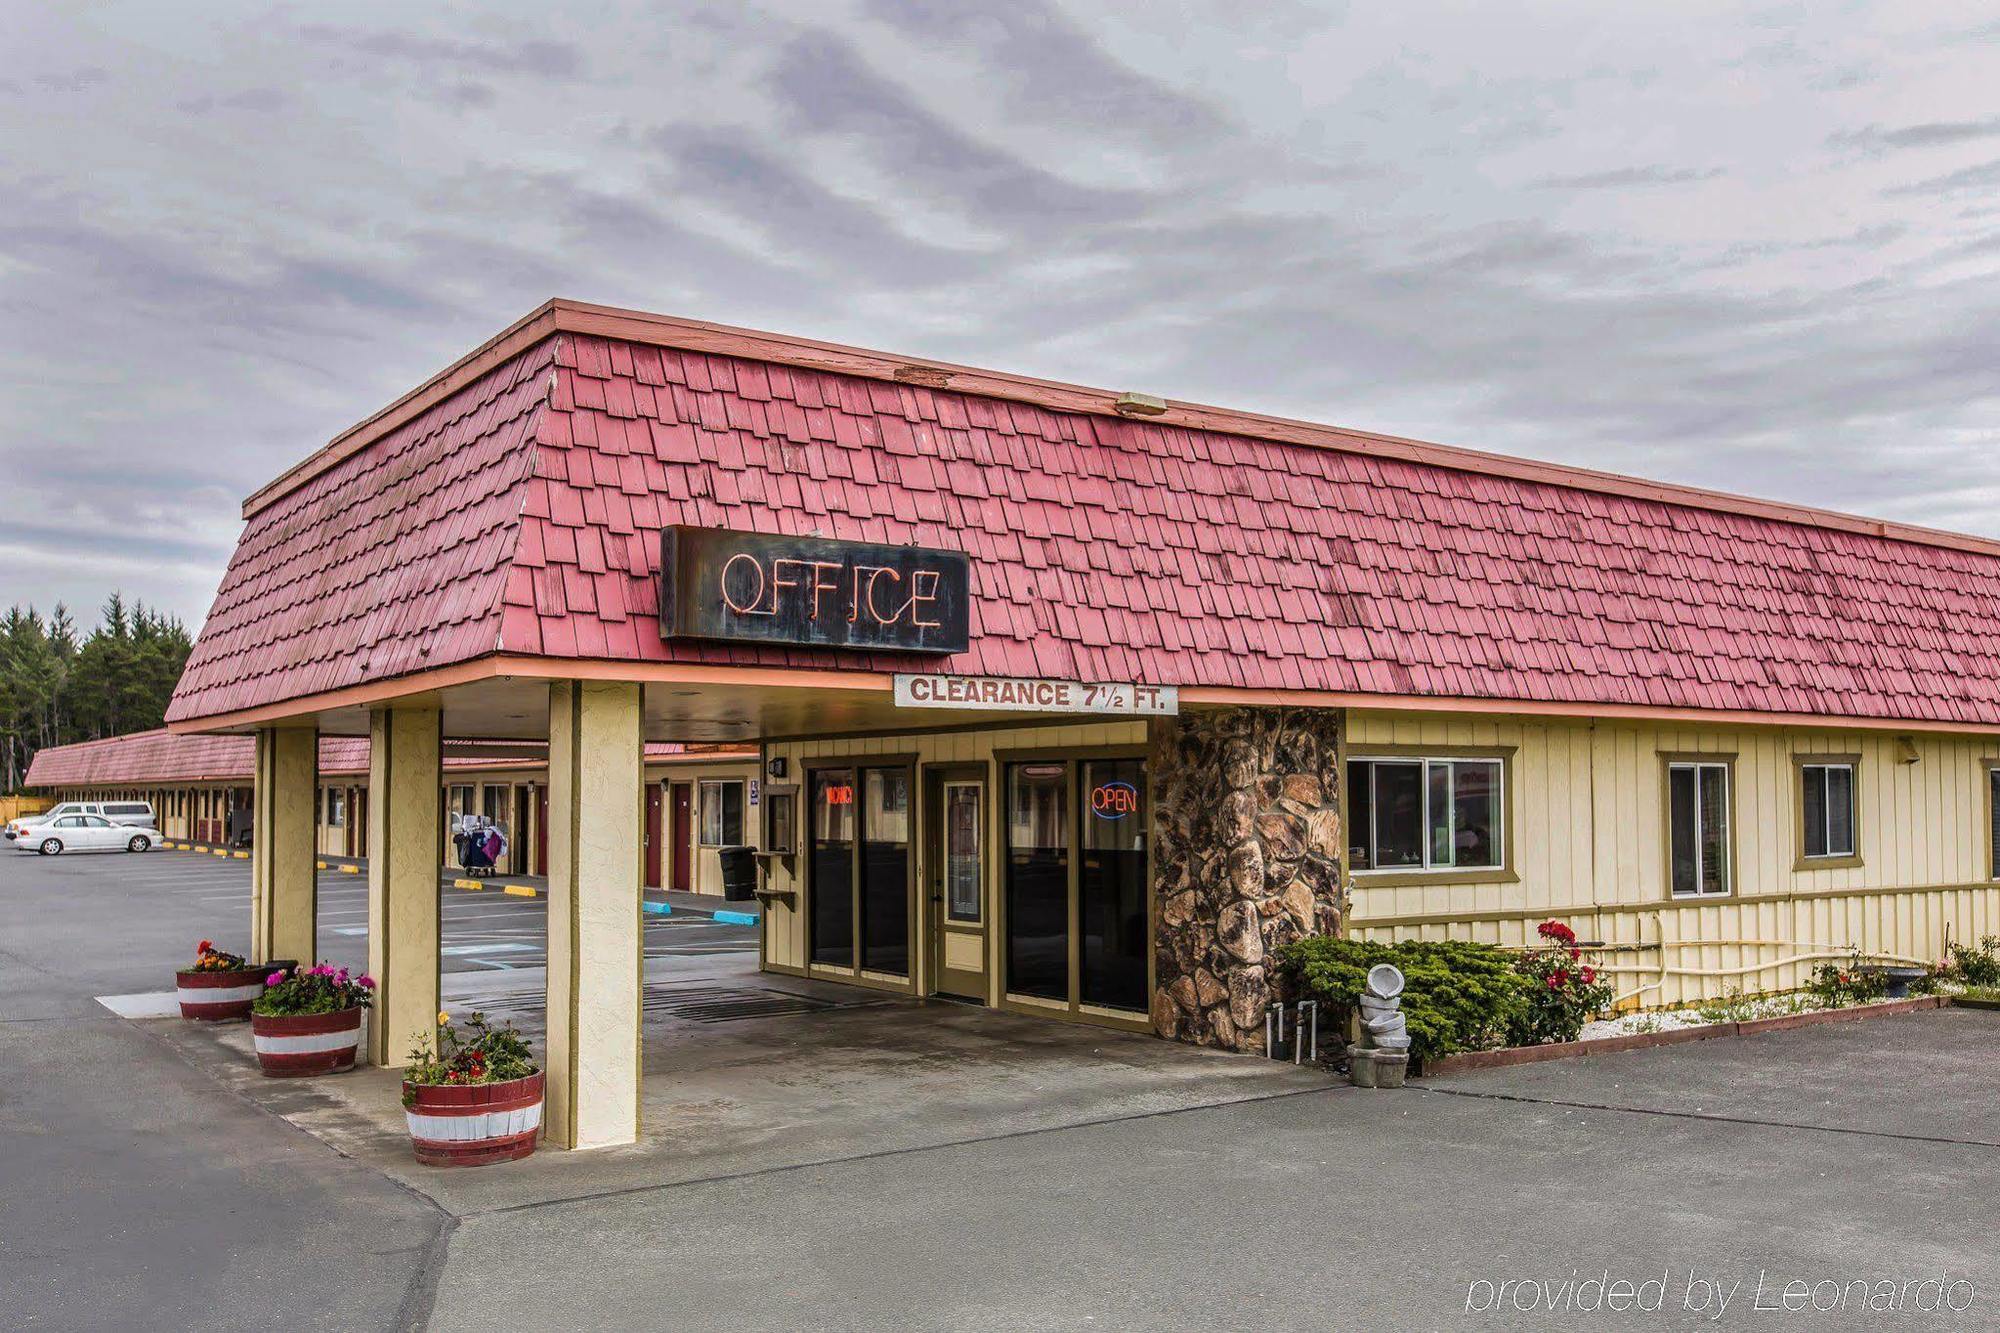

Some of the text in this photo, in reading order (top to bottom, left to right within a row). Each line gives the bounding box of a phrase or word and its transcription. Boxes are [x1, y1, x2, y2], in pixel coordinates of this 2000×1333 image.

[721, 553, 941, 626] OFFICE
[910, 677, 1071, 706] CLEARANCE
[1133, 687, 1166, 710] FT.
[1091, 787, 1137, 811] OPEN
